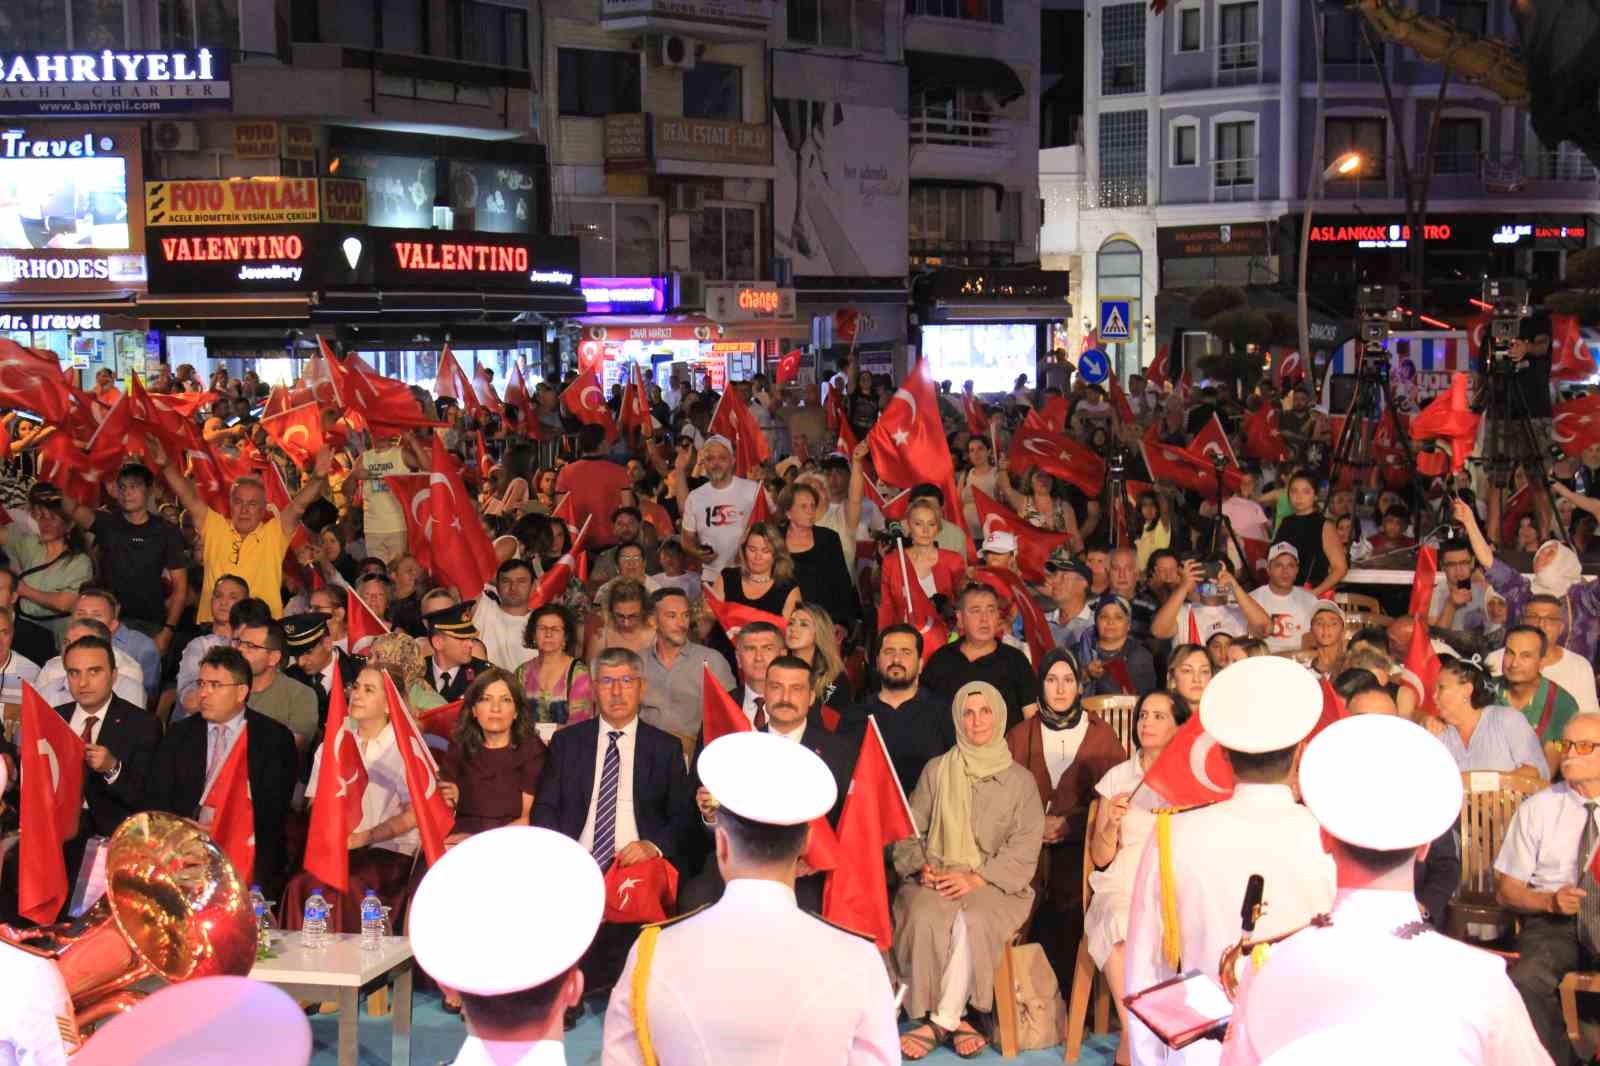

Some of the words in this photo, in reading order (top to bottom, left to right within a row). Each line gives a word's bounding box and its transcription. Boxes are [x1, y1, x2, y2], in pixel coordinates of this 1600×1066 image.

[0, 48, 213, 82] AHRİYELİ
[92, 84, 215, 98] CHARTER
[39, 101, 160, 113] www.bahriyeli.com
[1, 131, 95, 157] Travel
[170, 182, 225, 211] FOTO
[230, 181, 316, 210] YAYLALI
[161, 235, 303, 262] VALENTINO
[394, 242, 529, 272] VALENTINO
[13, 257, 109, 280] RHODES
[739, 287, 779, 312] change
[32, 313, 101, 331] Travel
